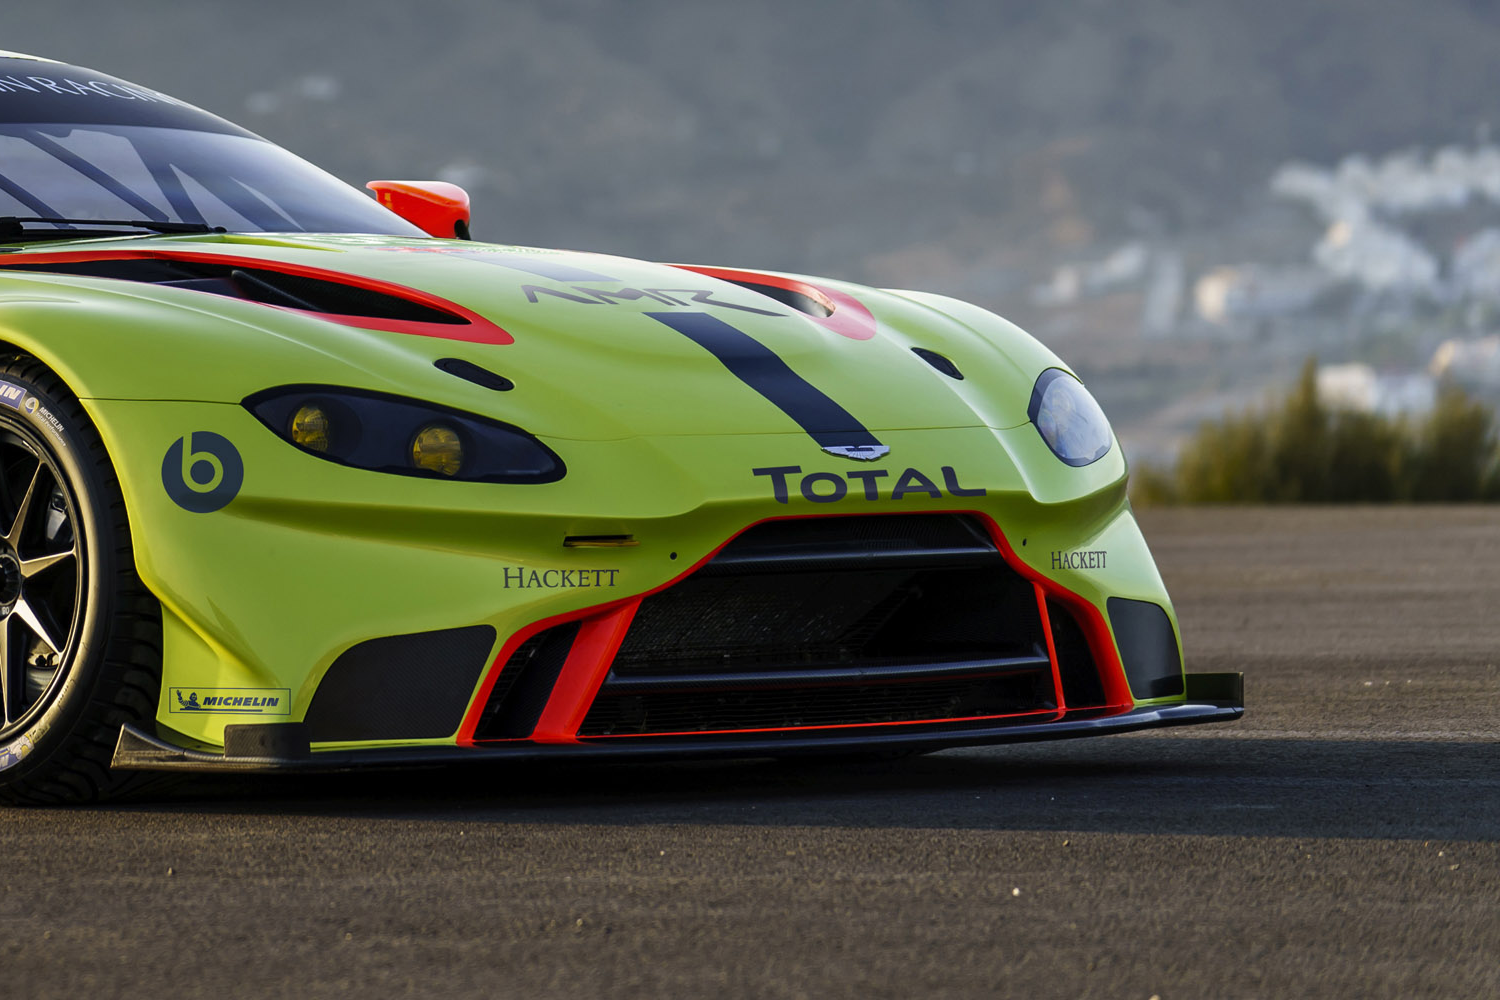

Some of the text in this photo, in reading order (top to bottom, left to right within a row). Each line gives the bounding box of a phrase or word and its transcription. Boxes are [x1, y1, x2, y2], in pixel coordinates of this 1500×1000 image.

[39, 406, 65, 433] MICHELIN
[752, 465, 987, 504] TOTAL
[1050, 550, 1107, 570] HACKETT
[502, 566, 620, 589] HACKETT
[203, 696, 279, 707] MICHELIN
